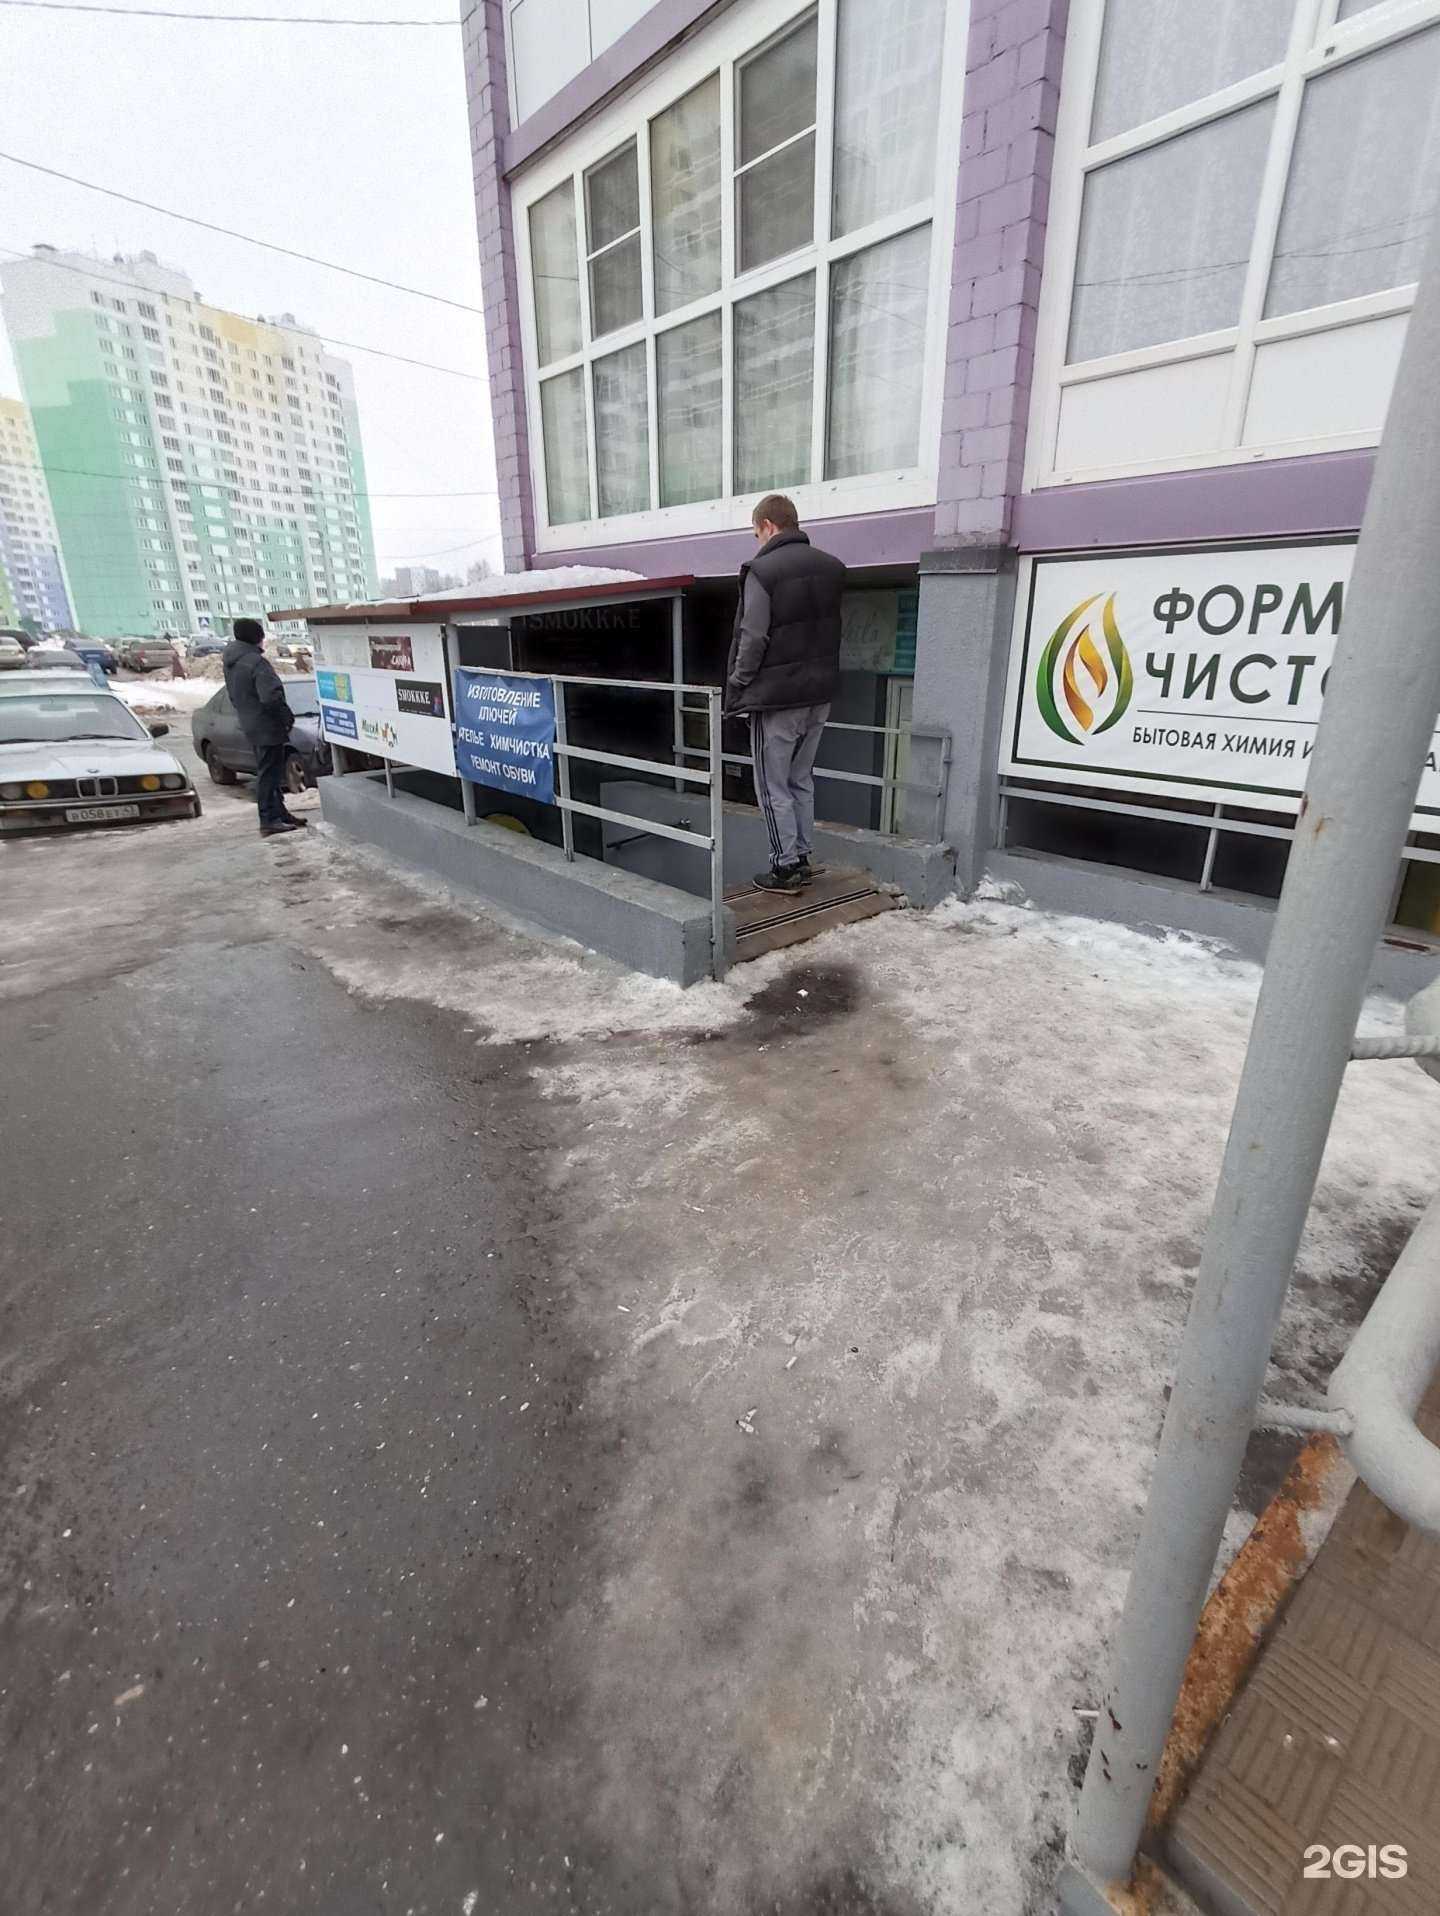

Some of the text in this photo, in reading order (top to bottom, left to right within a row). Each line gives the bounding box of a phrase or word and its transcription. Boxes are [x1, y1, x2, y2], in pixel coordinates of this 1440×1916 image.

[1145, 652, 1331, 706] ЧИСТ
[398, 688, 431, 705] SMOKKKE
[467, 684, 541, 708] ИЗГОТОВЛЕНИЕ
[490, 733, 551, 760] ХИМЧИСТКА
[1132, 726, 1217, 751] БЫТОВАЯ
[1221, 733, 1297, 759] ХИМИЯ
[502, 764, 537, 785] ОБУВИ
